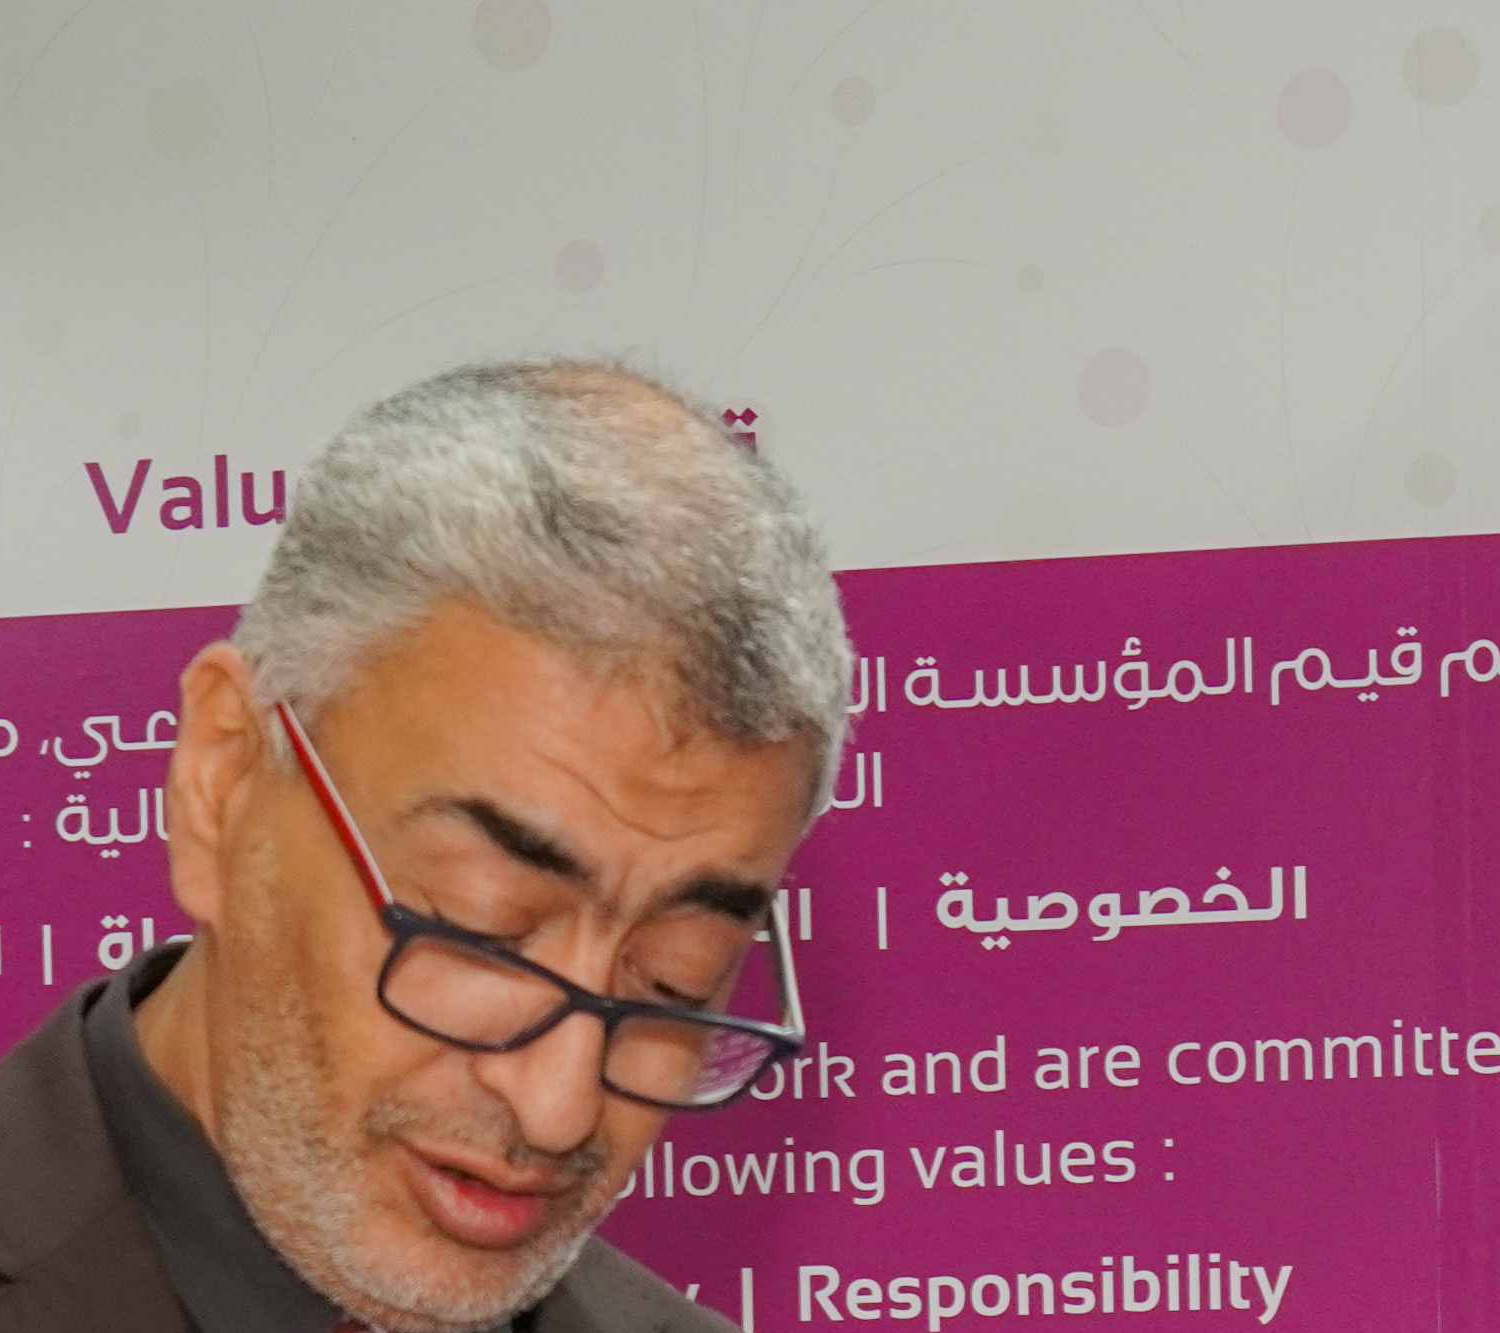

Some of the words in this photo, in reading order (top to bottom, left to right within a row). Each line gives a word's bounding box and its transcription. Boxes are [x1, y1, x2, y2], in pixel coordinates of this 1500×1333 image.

[83, 454, 287, 534] Valu
[856, 656, 886, 713] ال
[905, 637, 1252, 710] المؤسسة
[1271, 627, 1422, 705] قيم
[39, 709, 177, 779] عي،
[55, 787, 169, 859] الية
[937, 866, 1306, 950] الخصوصية
[750, 1041, 857, 1101] ork
[883, 1035, 1006, 1095] and
[1035, 1045, 1140, 1089] are
[613, 1136, 886, 1206] llowing
[910, 1130, 1135, 1188] values
[799, 1253, 1293, 1332] Responsibility
